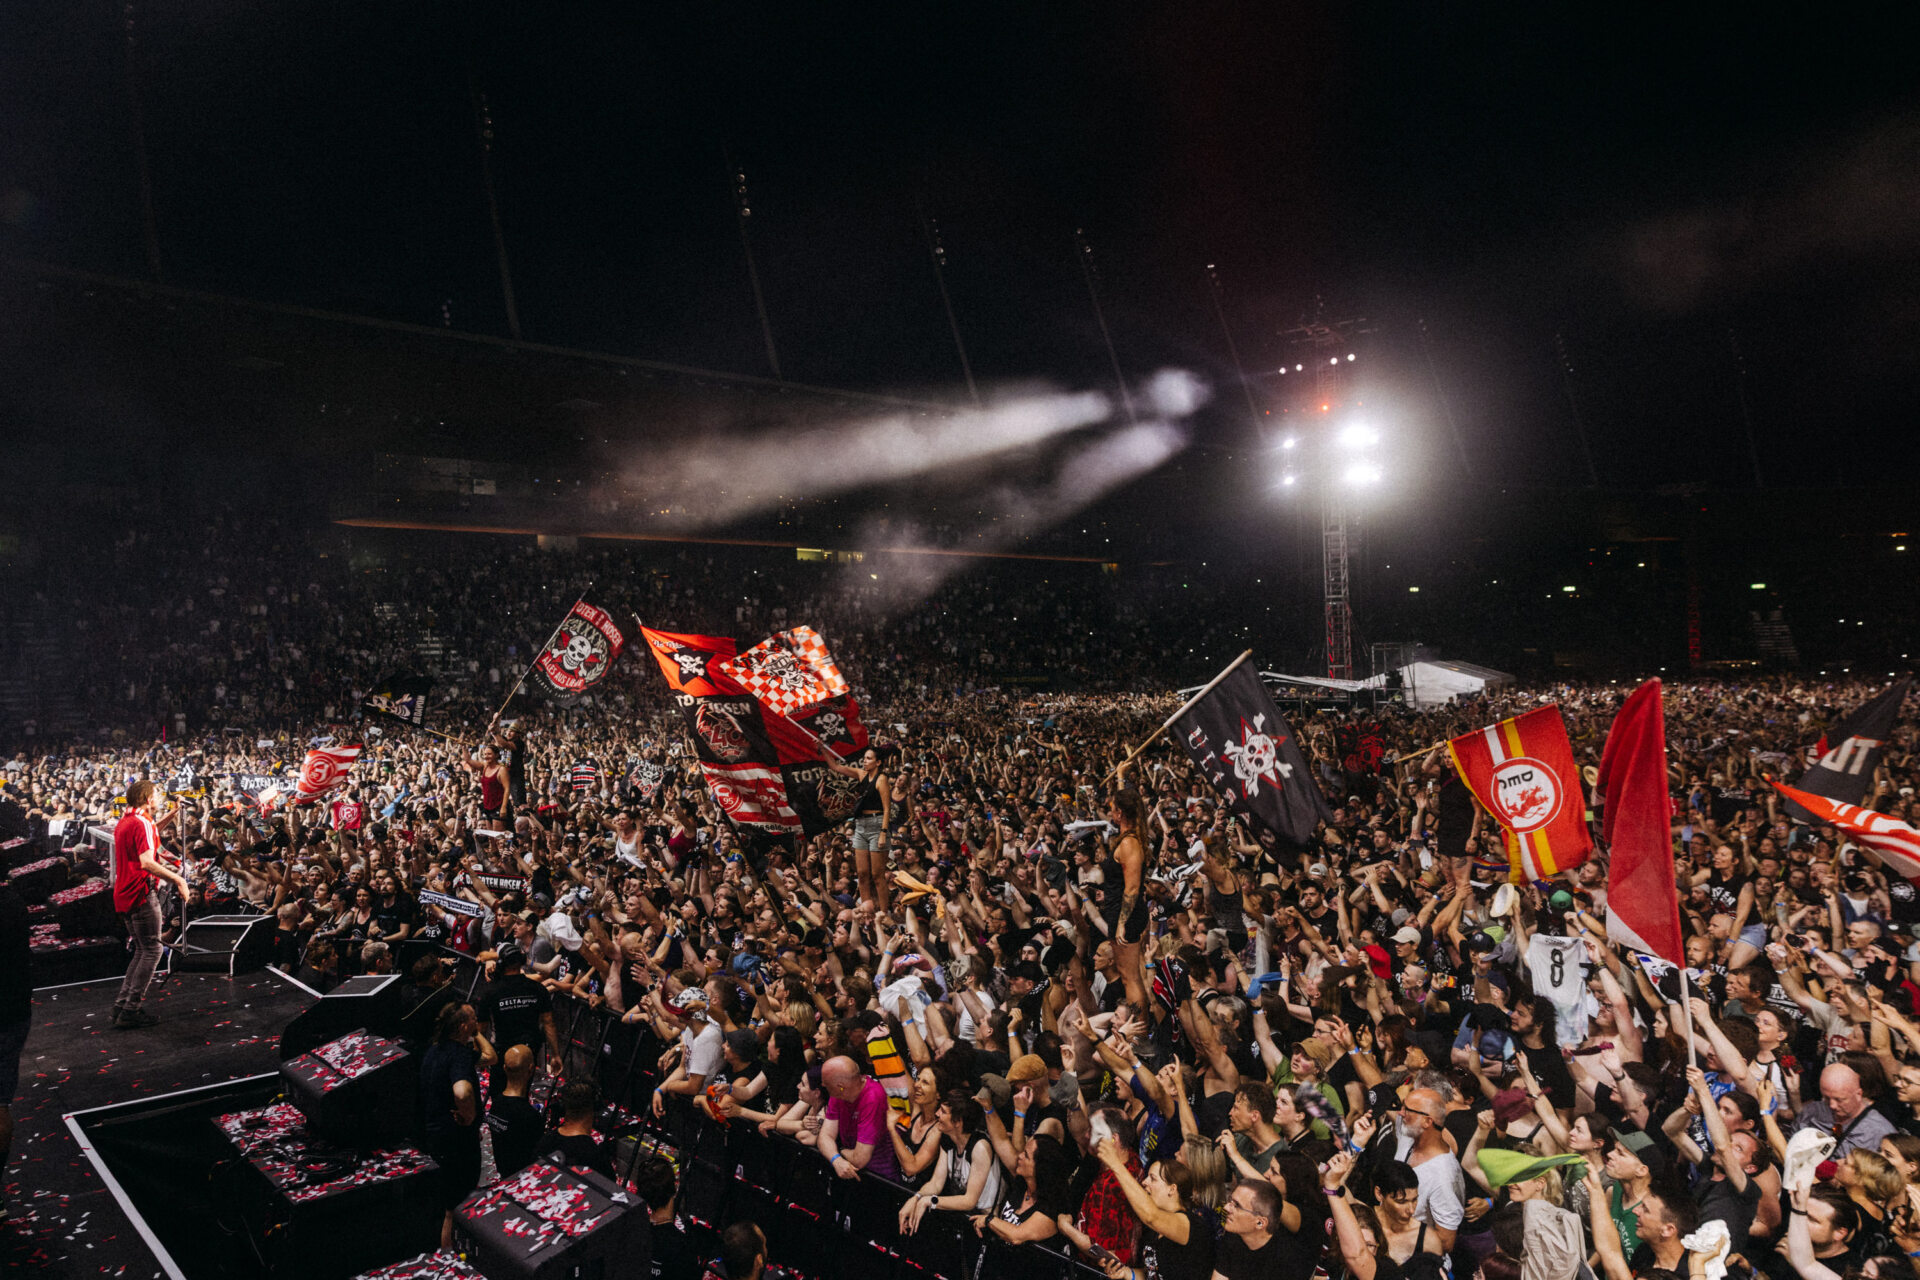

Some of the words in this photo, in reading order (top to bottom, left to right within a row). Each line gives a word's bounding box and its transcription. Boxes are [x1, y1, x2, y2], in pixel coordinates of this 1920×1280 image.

[541, 656, 557, 676] ALLES
[553, 671, 567, 685] AUS
[723, 797, 734, 805] 95
[499, 878, 521, 890] HOSEN
[1550, 948, 1564, 988] 8
